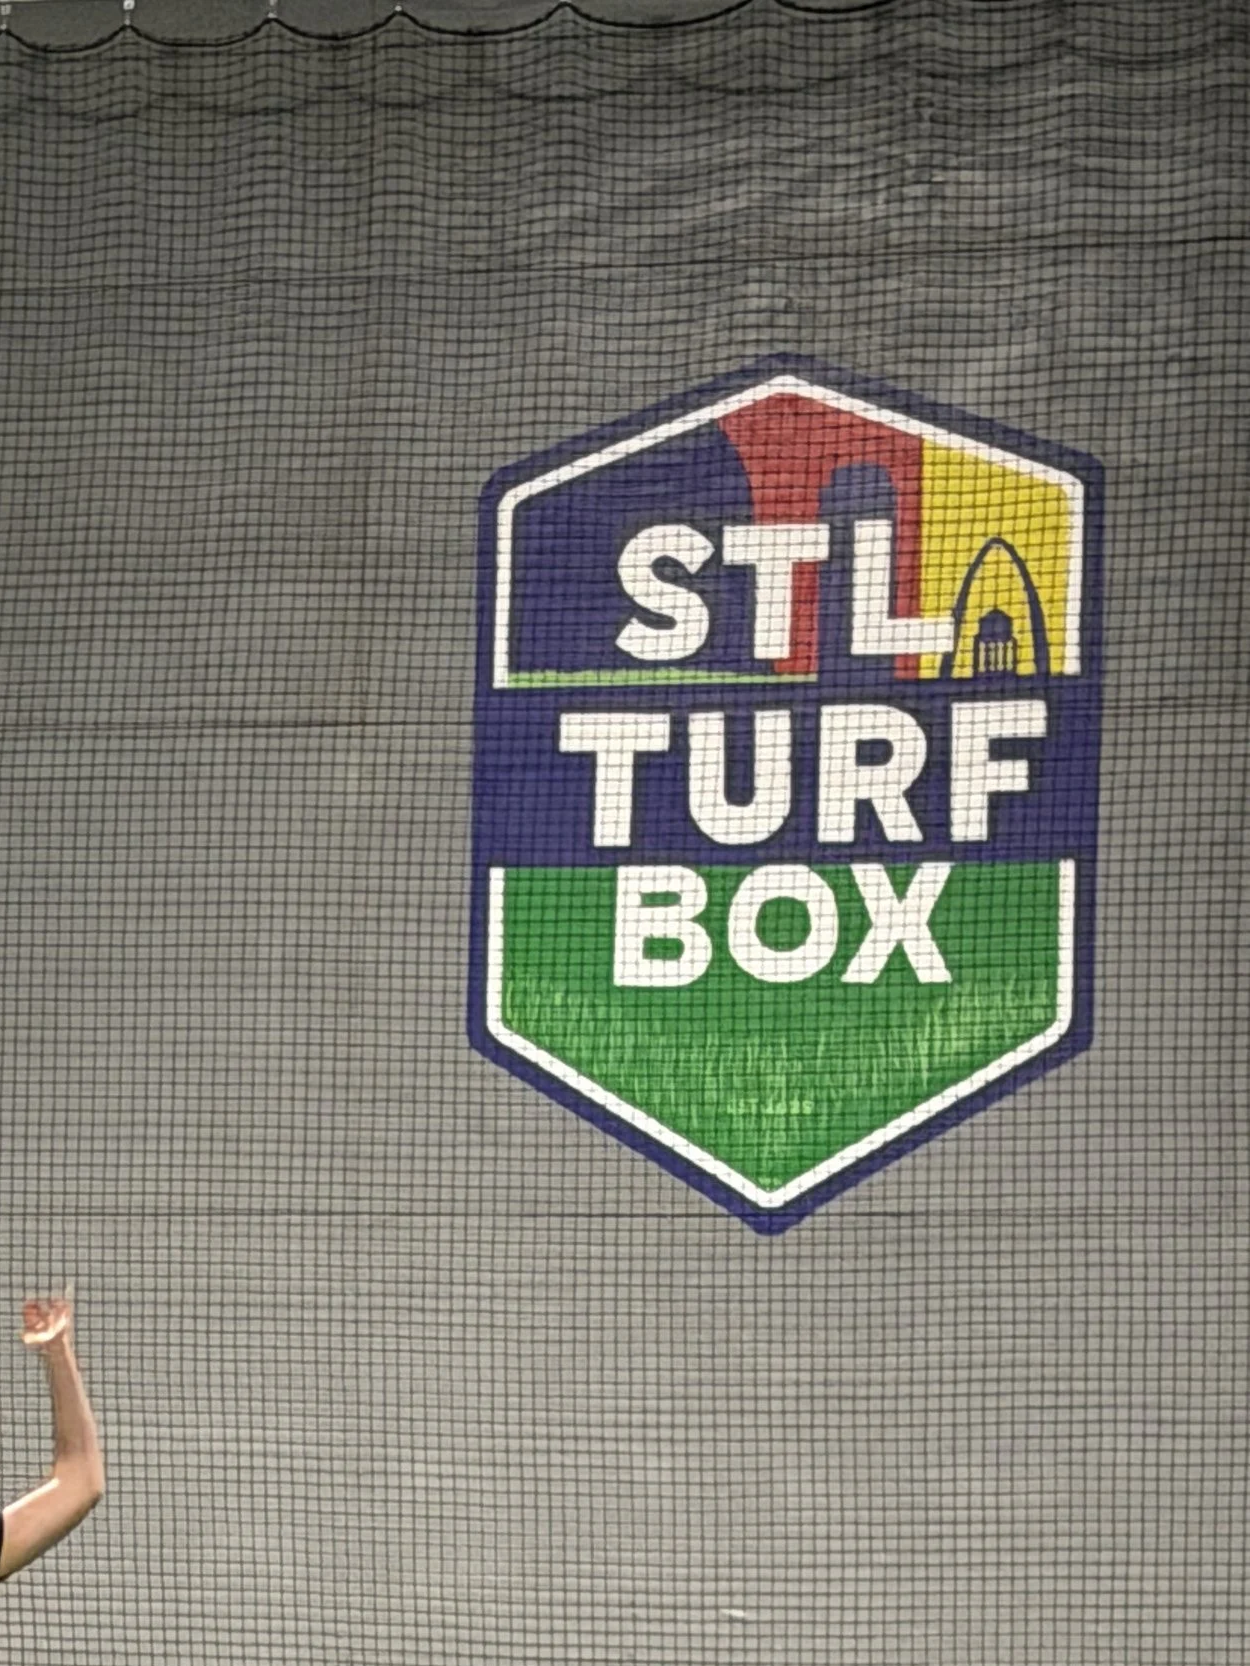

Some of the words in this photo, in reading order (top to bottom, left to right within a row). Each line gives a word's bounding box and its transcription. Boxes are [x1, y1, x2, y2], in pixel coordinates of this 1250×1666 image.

[614, 518, 956, 662] STL
[558, 699, 1048, 847] TURF
[612, 861, 954, 988] BOX
